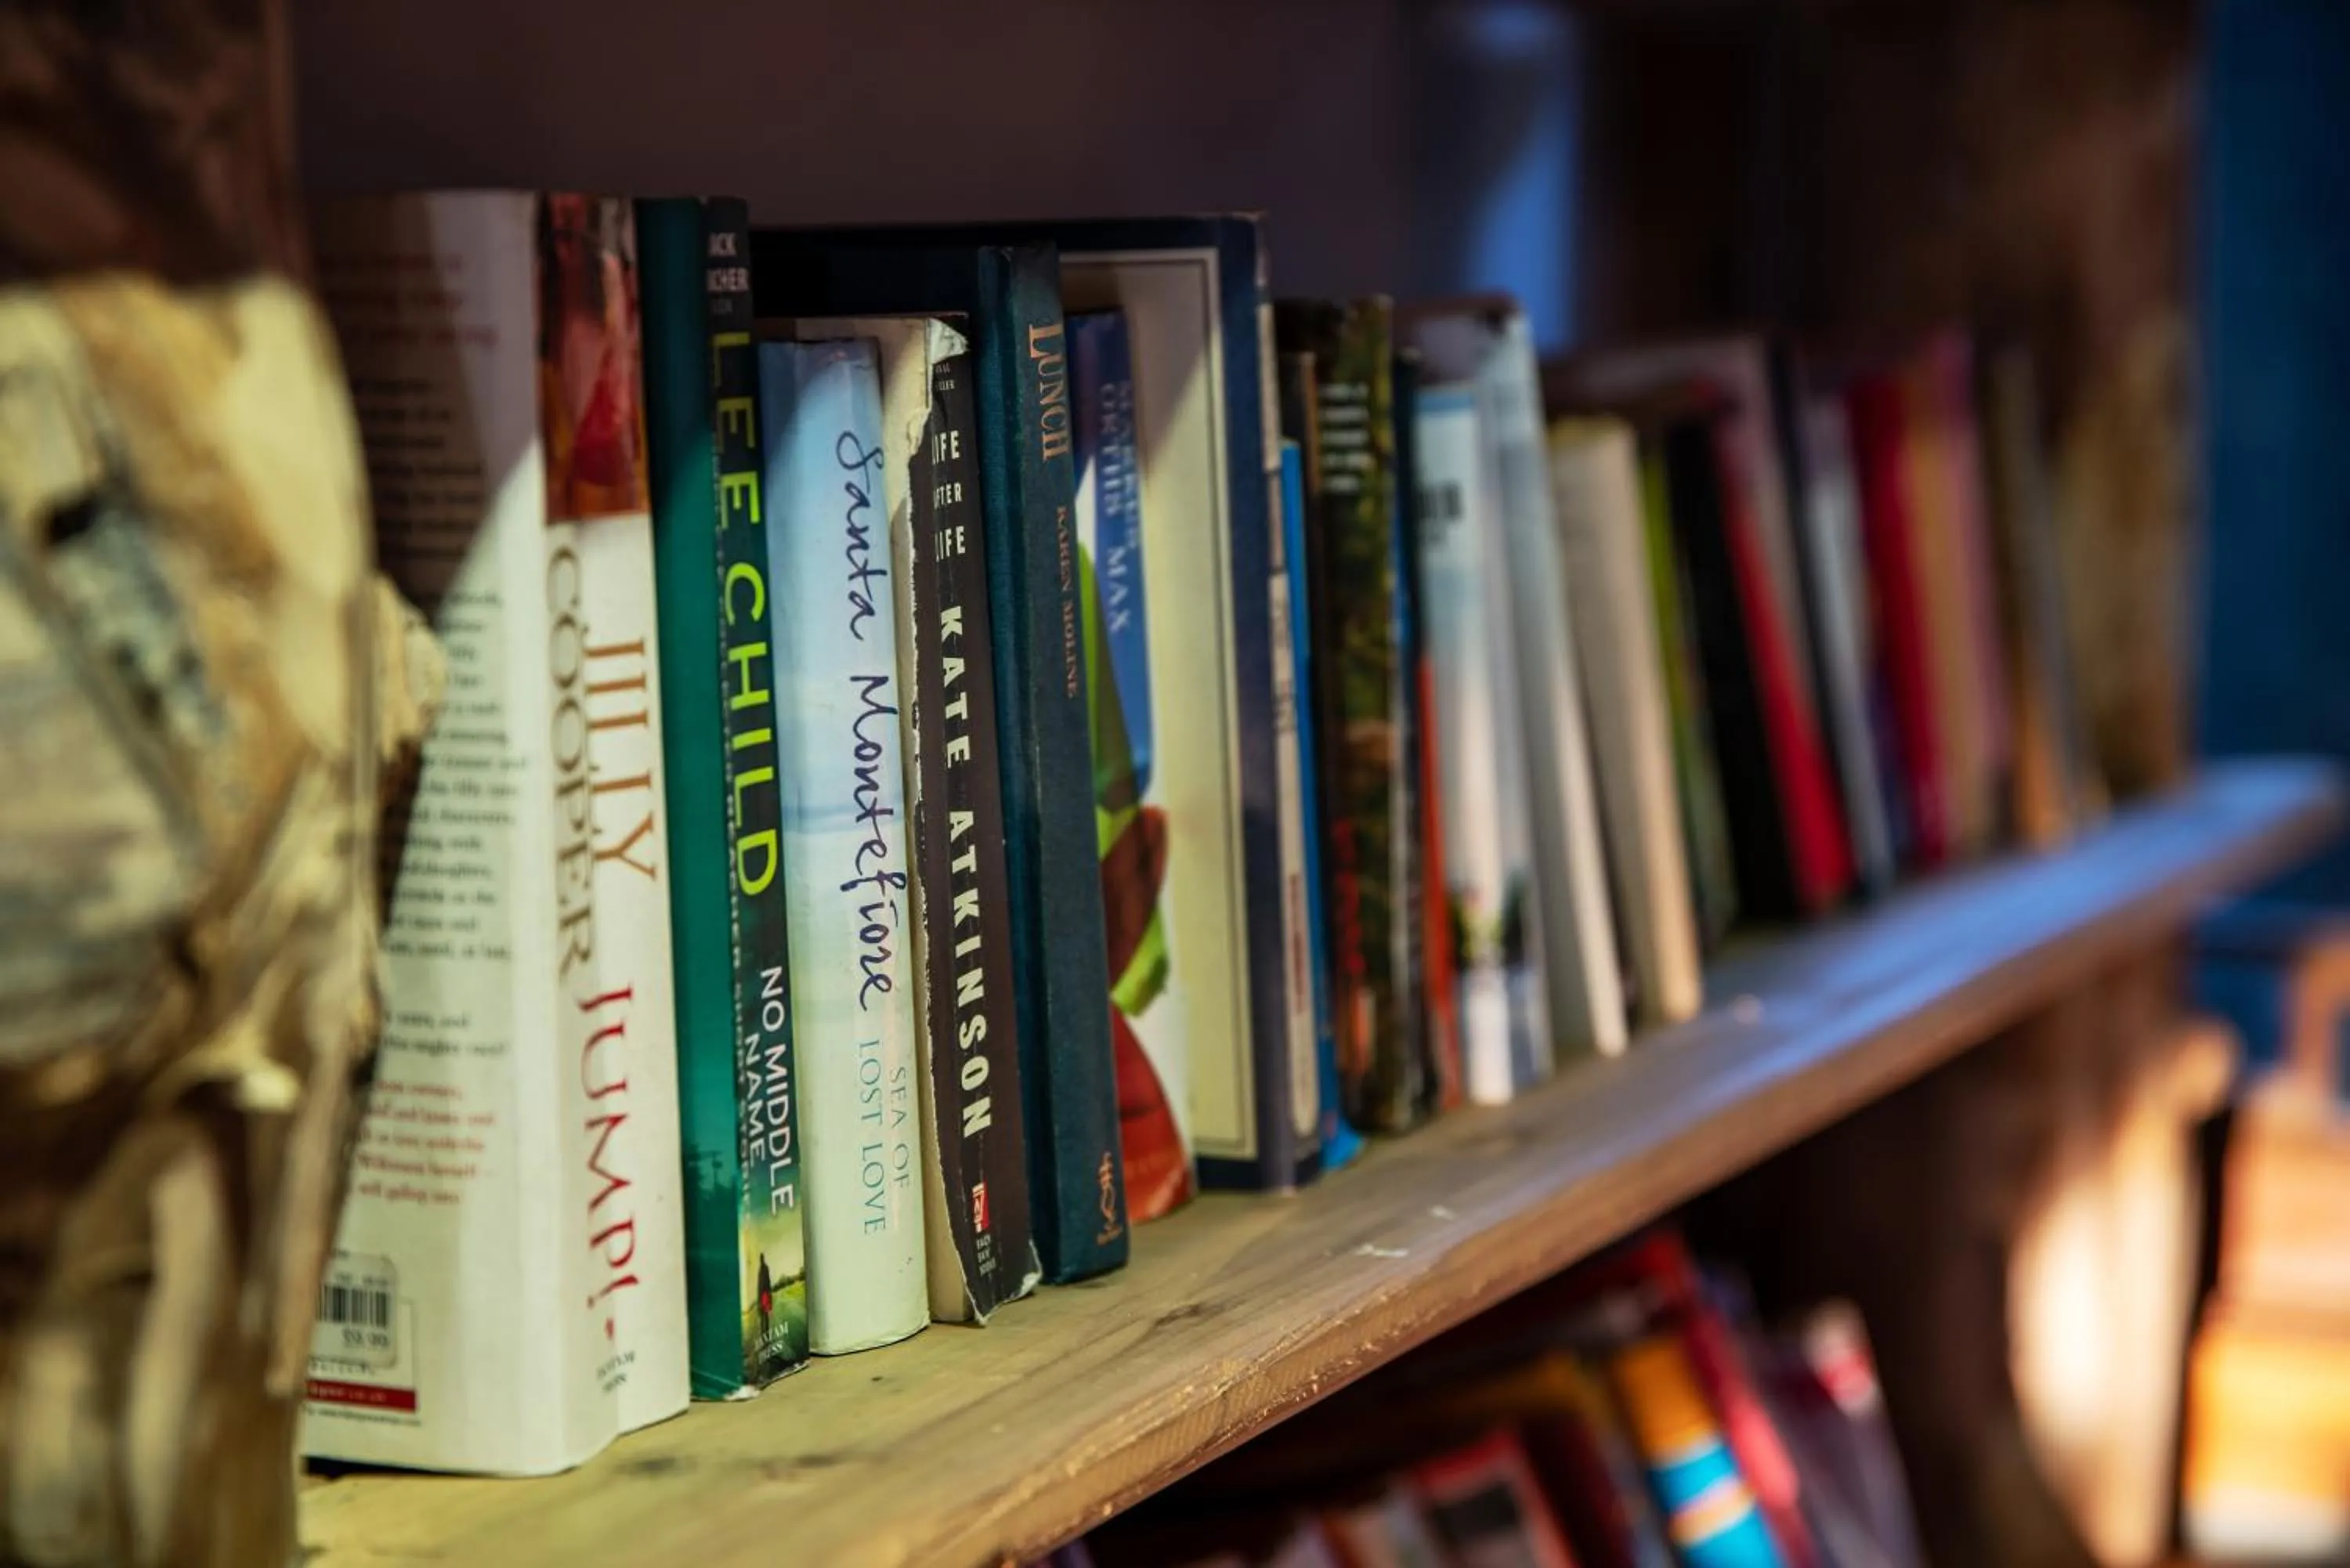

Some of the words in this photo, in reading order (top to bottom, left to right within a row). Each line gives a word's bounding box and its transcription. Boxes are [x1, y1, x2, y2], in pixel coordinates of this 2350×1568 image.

[712, 331, 761, 530] LEE
[1029, 323, 1069, 463] LUNCH
[836, 431, 888, 641] Santa
[549, 544, 593, 976] COOPER
[582, 623, 657, 883] JILLY
[725, 562, 778, 895] CHILD
[941, 605, 971, 768] KATE
[840, 676, 907, 1012] Montefiore
[760, 966, 785, 1032] NO
[949, 811, 992, 1138] ATKINSON
[745, 1032, 765, 1168] NAME
[765, 1043, 794, 1215] MIDDLE
[859, 1039, 884, 1125] LOST
[889, 1066, 907, 1128] SEA
[892, 1143, 909, 1188] OF
[862, 1143, 887, 1234] LOVE
